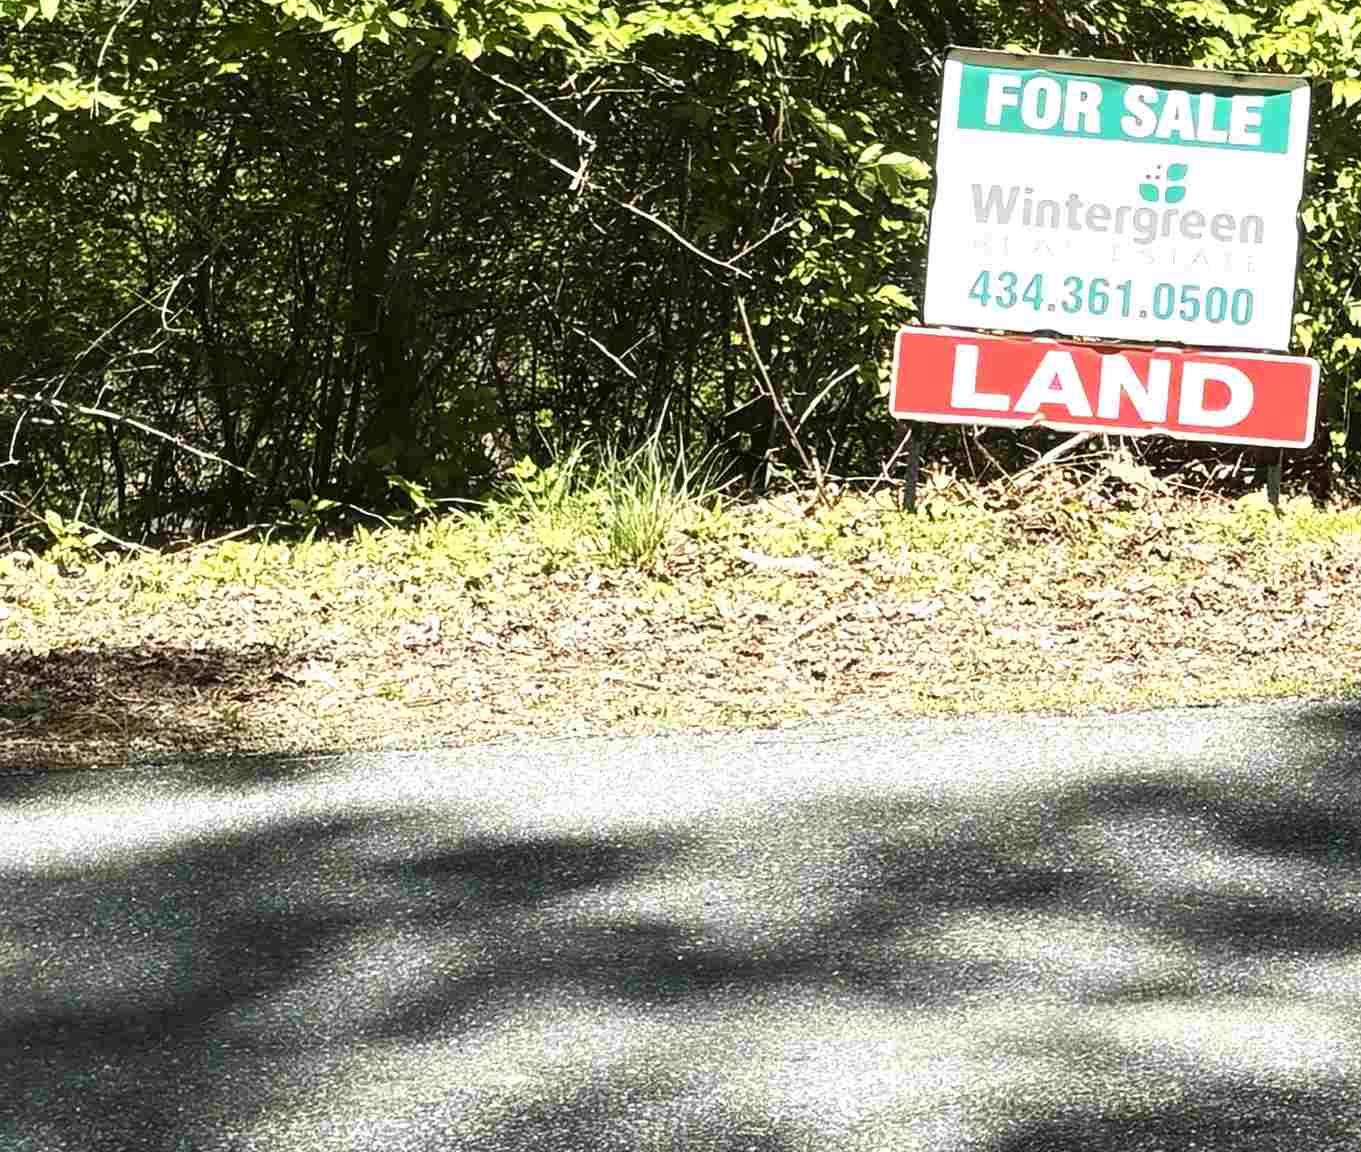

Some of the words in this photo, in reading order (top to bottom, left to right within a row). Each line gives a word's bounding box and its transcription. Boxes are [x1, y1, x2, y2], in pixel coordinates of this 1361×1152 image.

[984, 74, 1102, 134] FOR
[1121, 85, 1265, 146] SALE
[970, 183, 1265, 245] Wintergreen
[967, 269, 1255, 326] 434.361.0500
[950, 343, 1255, 428] LAND
